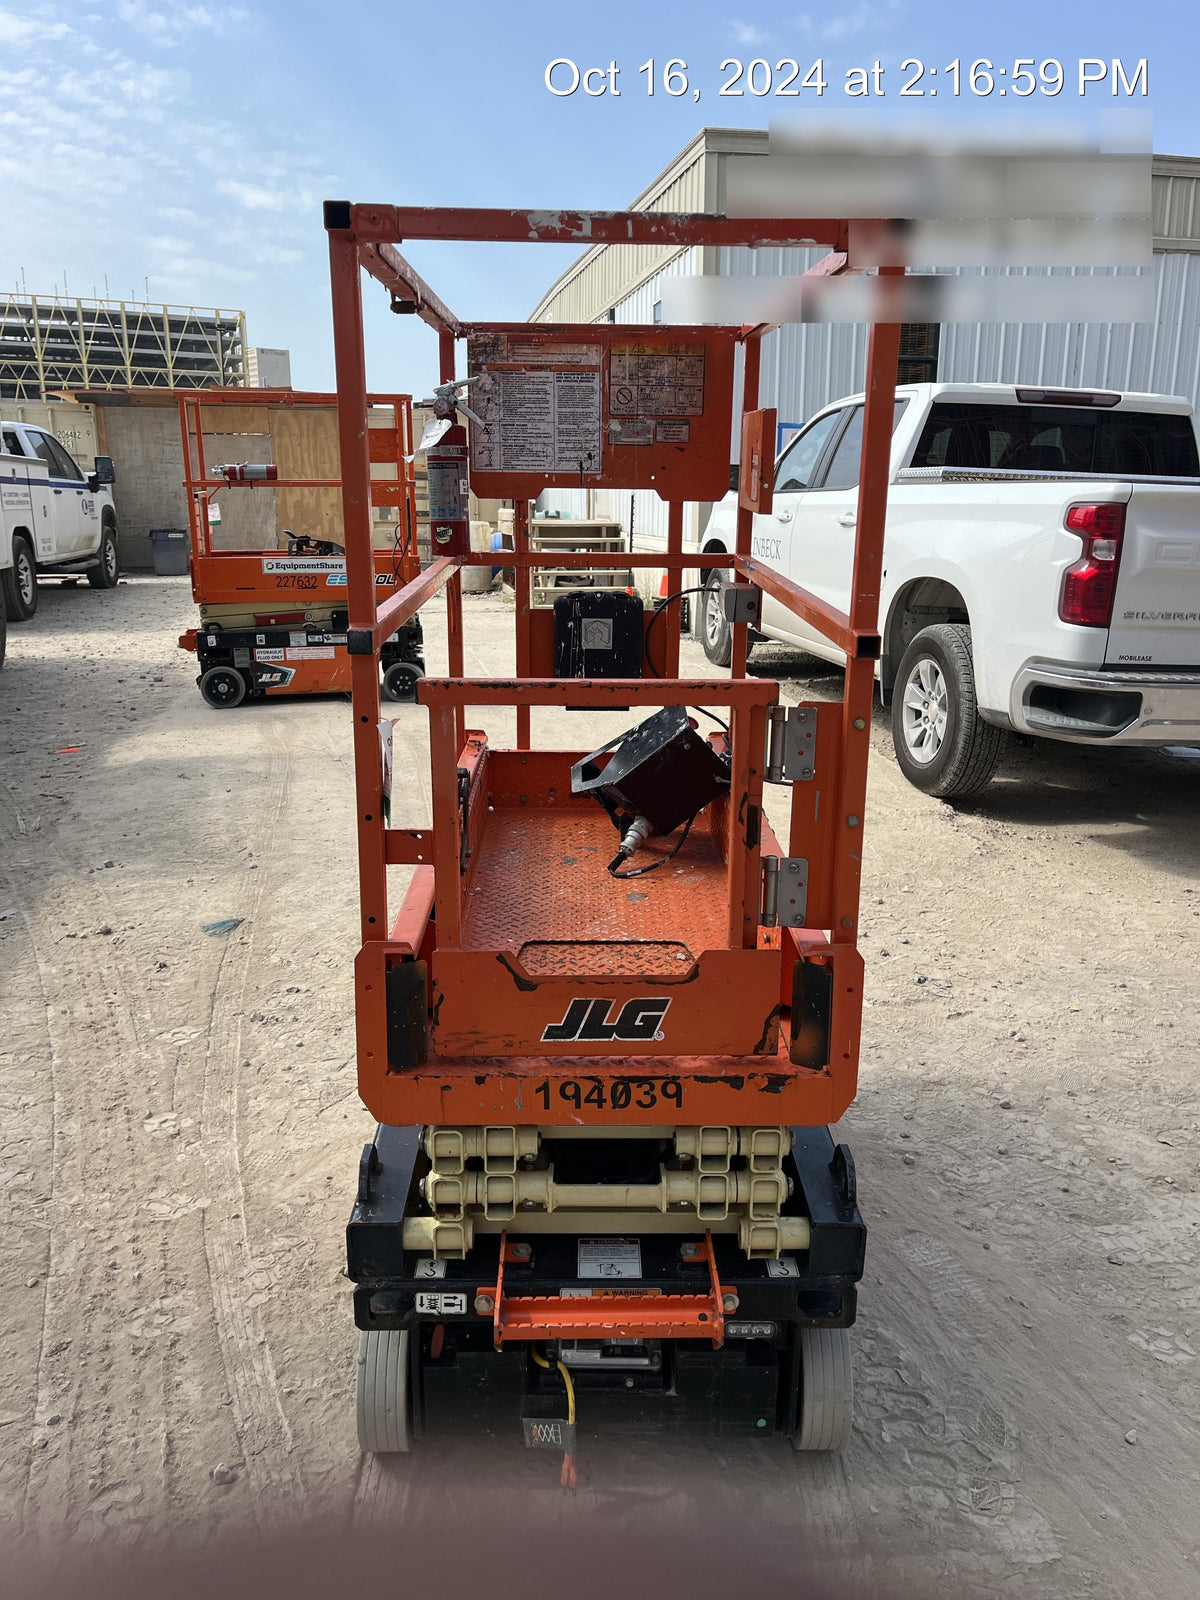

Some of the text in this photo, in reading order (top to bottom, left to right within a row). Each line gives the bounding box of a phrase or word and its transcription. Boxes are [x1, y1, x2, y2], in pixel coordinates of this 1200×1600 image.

[750, 536, 782, 560] INBECK
[275, 562, 343, 570] EquipmentShare
[275, 575, 318, 589] 227632
[1122, 610, 1200, 621] SILVERA
[258, 673, 282, 682] JLG
[540, 997, 673, 1042] JLG
[534, 1080, 684, 1110] 194039
